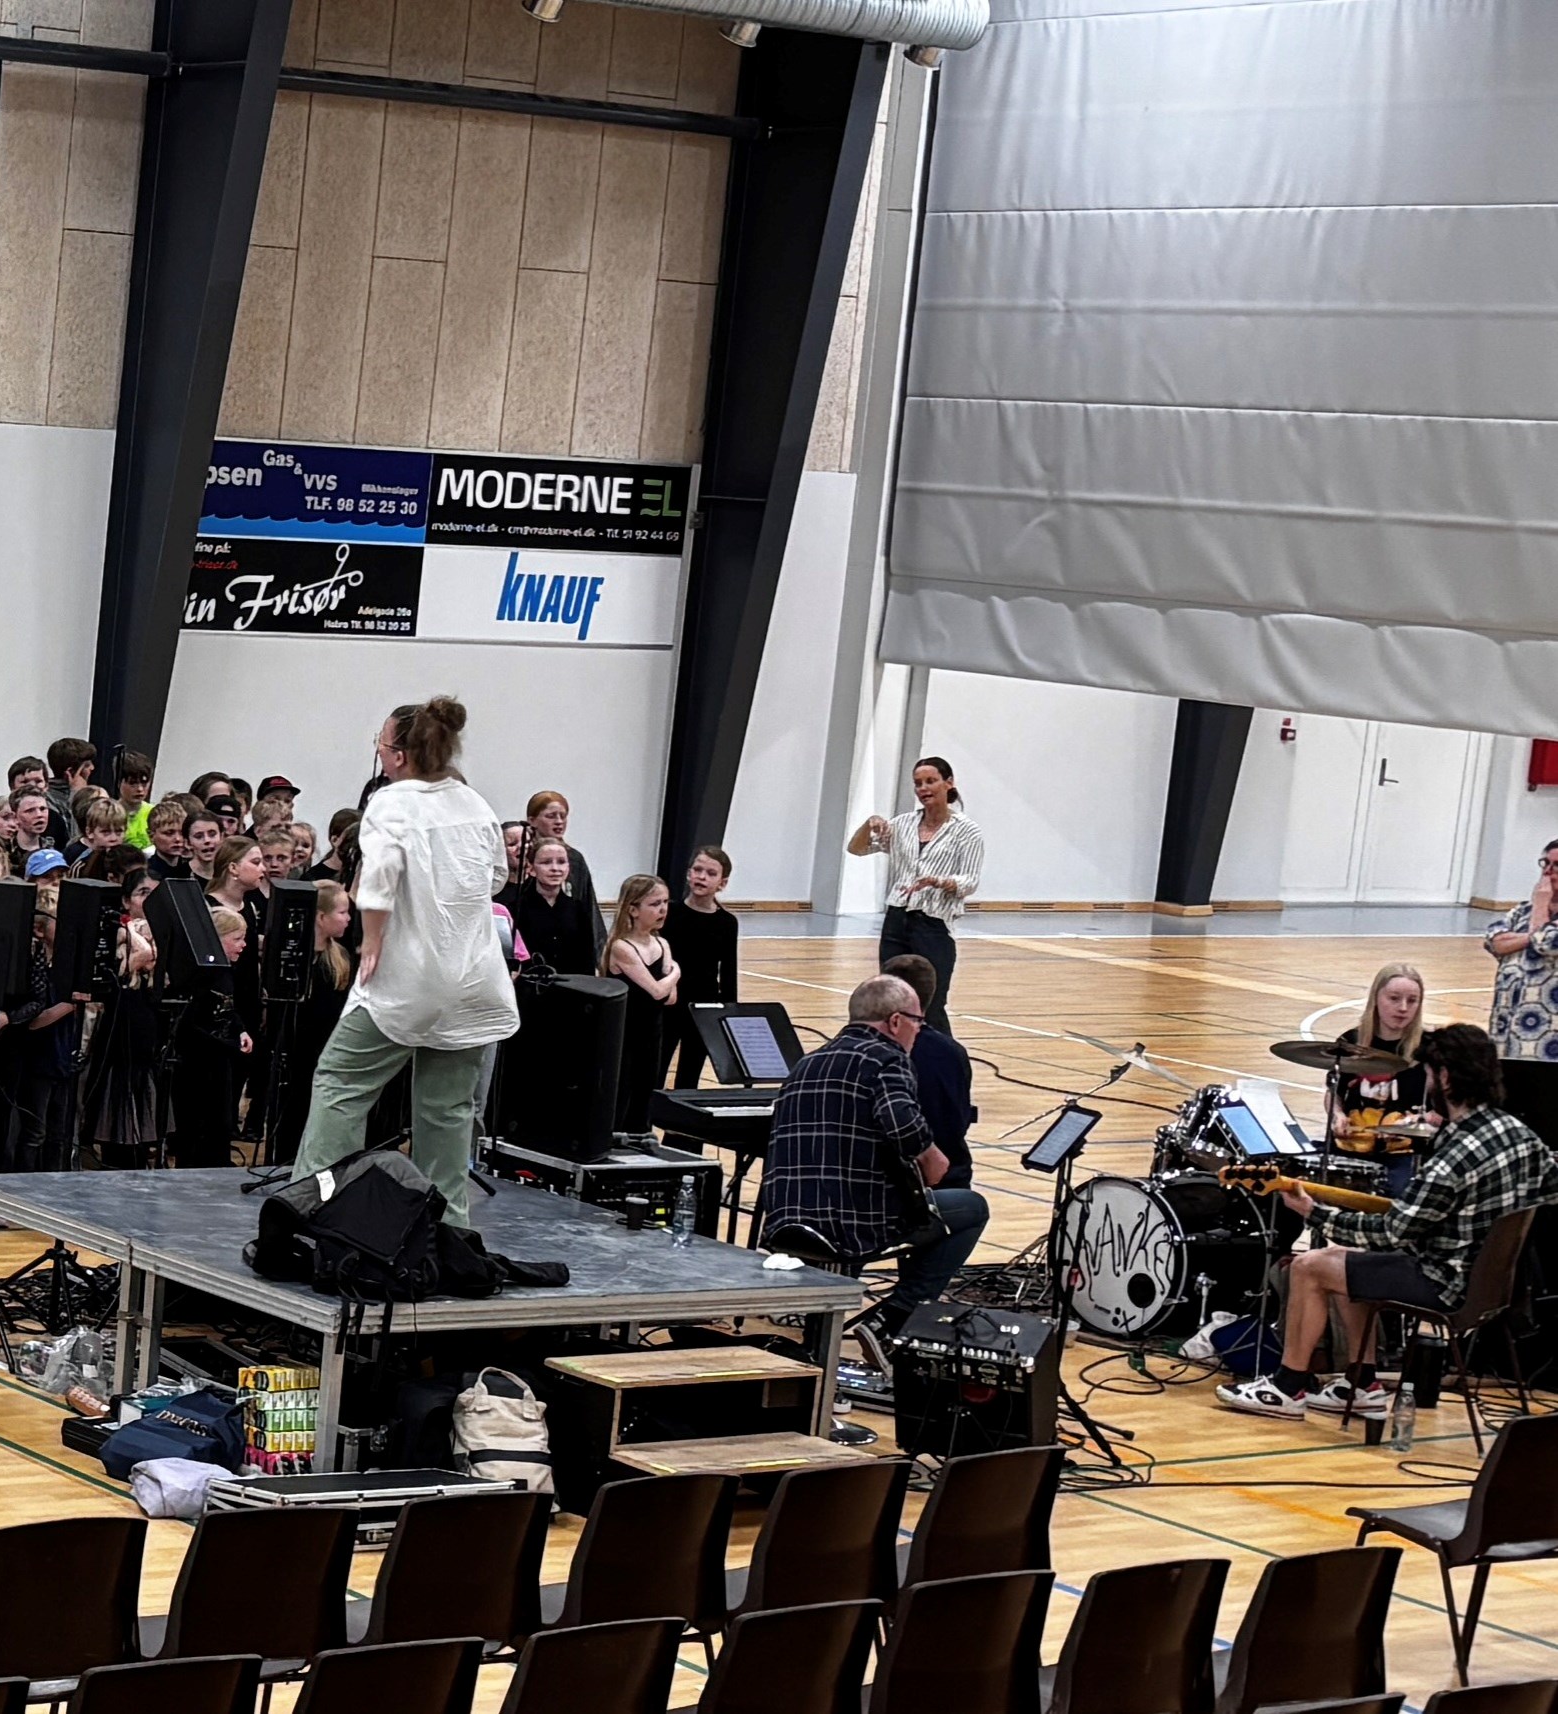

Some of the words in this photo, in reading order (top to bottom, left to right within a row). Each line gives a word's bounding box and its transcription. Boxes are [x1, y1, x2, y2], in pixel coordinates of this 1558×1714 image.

[263, 449, 295, 467] Gas
[294, 463, 303, 475] &
[303, 474, 338, 491] VVS
[305, 496, 332, 510] TLF.
[337, 498, 354, 511] 98
[358, 499, 375, 512] 52
[378, 500, 396, 513] 25
[400, 501, 417, 515] 30
[436, 468, 634, 515] MODERNE
[635, 530, 648, 540] 92
[496, 551, 605, 641] KNAUF
